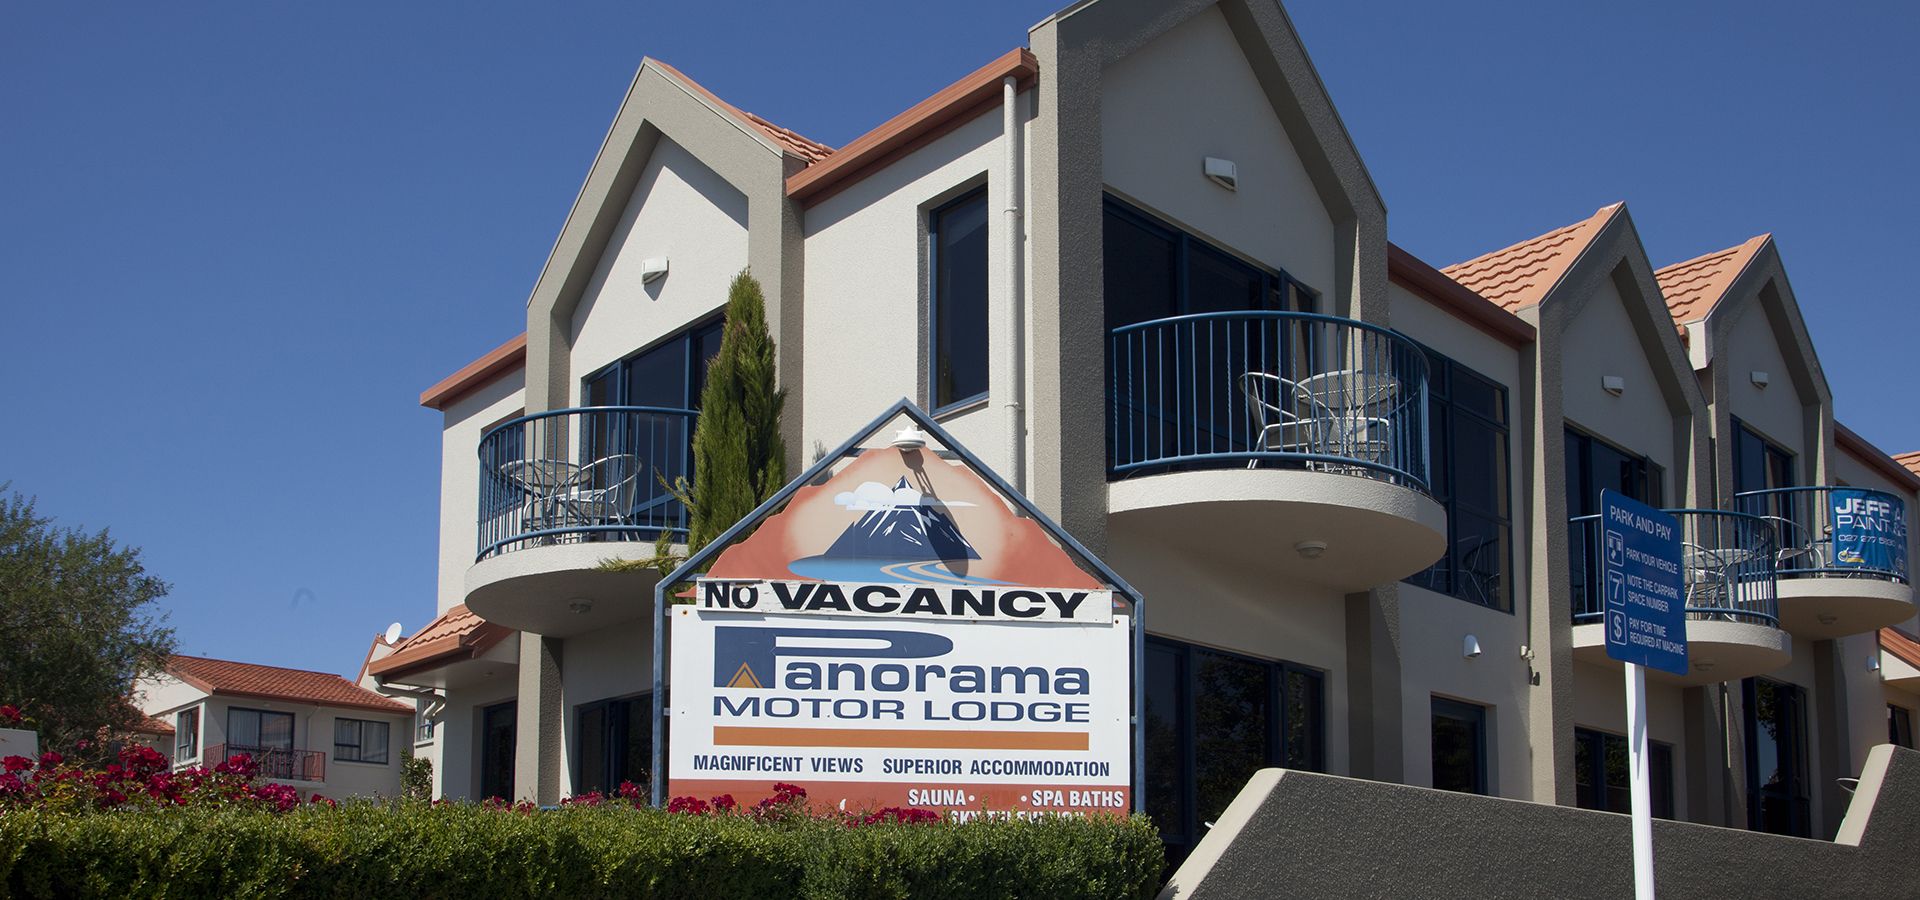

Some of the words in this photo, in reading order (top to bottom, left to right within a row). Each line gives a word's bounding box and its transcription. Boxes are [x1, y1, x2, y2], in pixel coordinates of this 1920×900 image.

[1835, 498, 1890, 517] JEFF
[1610, 505, 1634, 528] PARK
[1635, 515, 1654, 534] AND
[1655, 522, 1671, 541] PAY
[1839, 534, 1858, 542] 027
[1626, 547, 1640, 562] PARK
[1641, 551, 1655, 567] YOUR
[1655, 558, 1678, 575] VEHICLE
[1627, 574, 1642, 589] NOTE
[1642, 579, 1653, 592] THE
[1653, 582, 1679, 600] CARPARK
[771, 582, 1090, 619] VACANCY
[1628, 590, 1646, 606] SPACE
[1646, 596, 1669, 613] NUMBER
[1629, 617, 1640, 630] PAY
[1640, 620, 1653, 634] FOR
[1653, 623, 1667, 638] TIME
[1630, 631, 1655, 648] REQUIRED
[1655, 638, 1662, 649] AT
[1662, 640, 1685, 656] MACHINE
[714, 626, 1090, 695] Panorama
[713, 696, 904, 720] MOTOR
[924, 700, 1090, 723] LODGE
[694, 754, 803, 773] MAGNIFICENT
[811, 755, 864, 774] VIEWS
[882, 758, 962, 776] SUPERIOR
[970, 759, 1110, 778] ACCOMMODATION
[908, 788, 967, 807] SAUNA
[1031, 790, 1065, 808] SPA
[1070, 790, 1124, 808] BATHS
